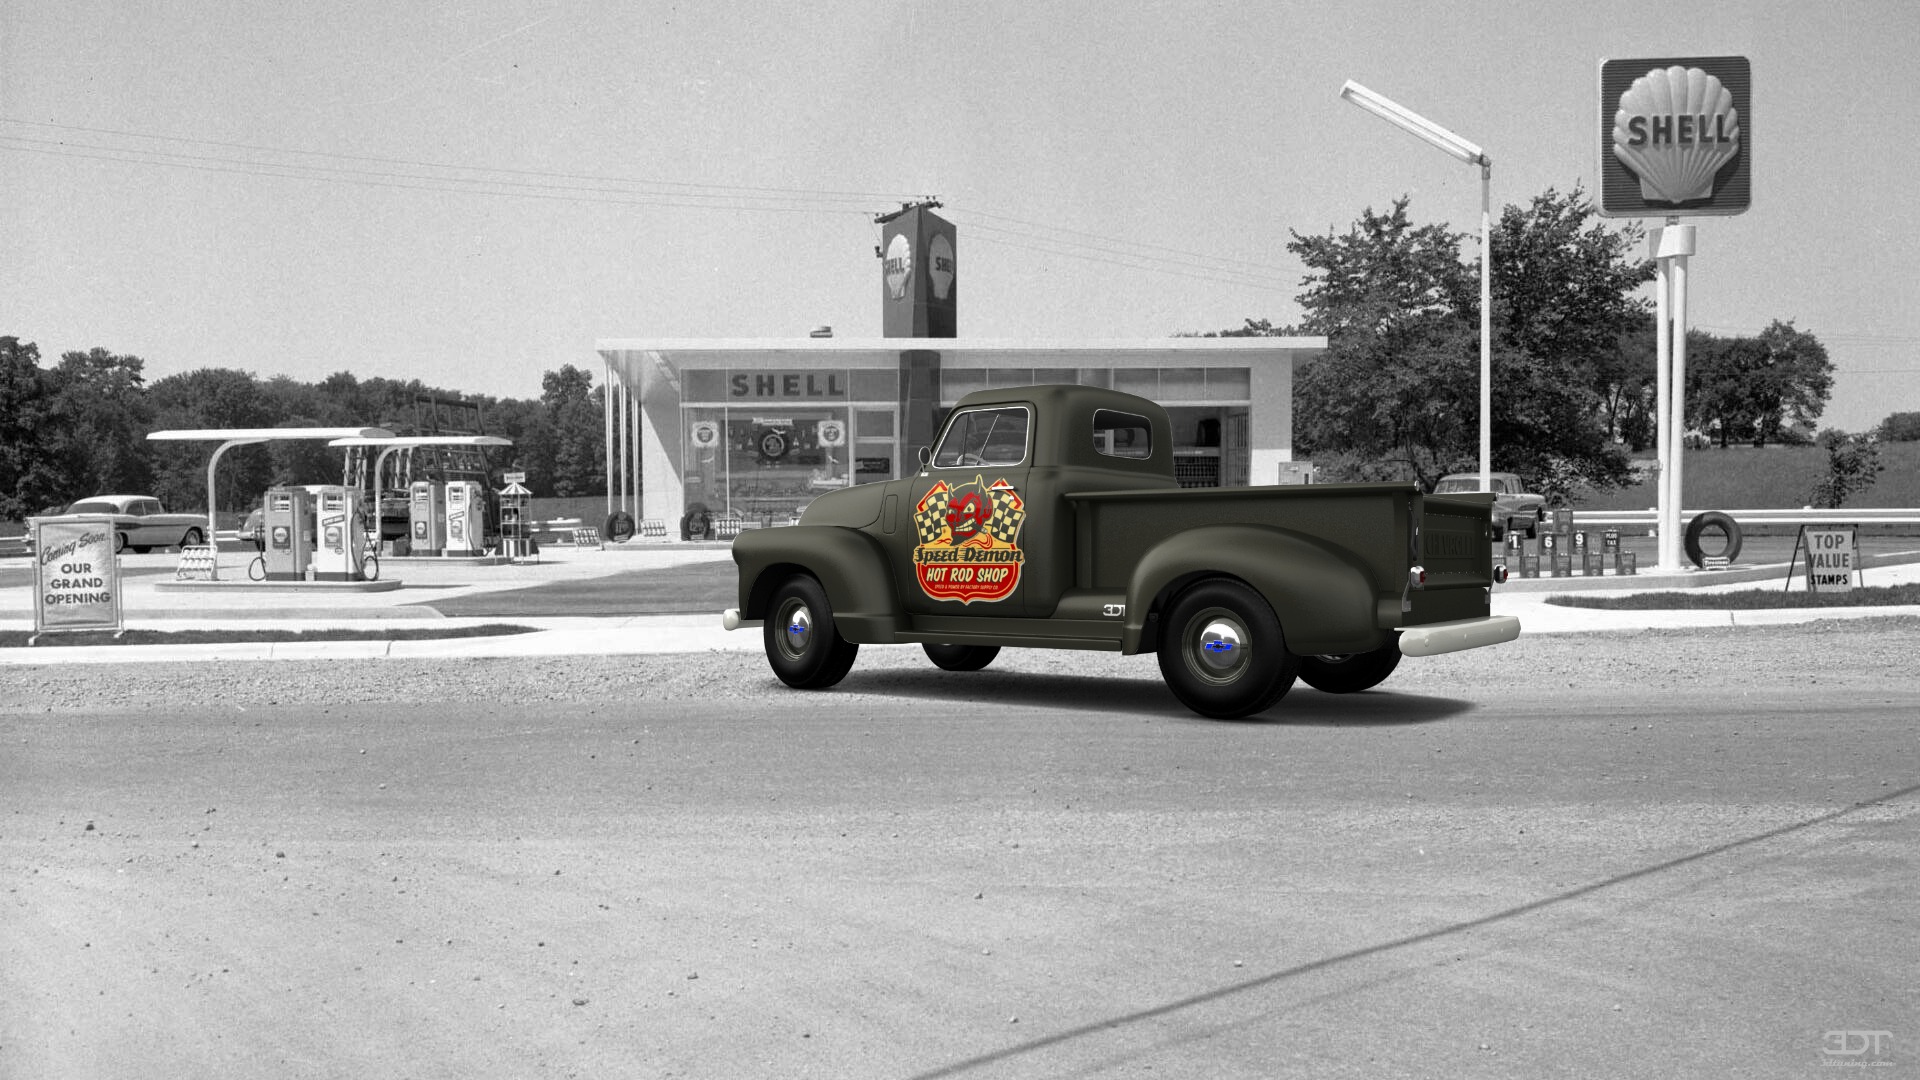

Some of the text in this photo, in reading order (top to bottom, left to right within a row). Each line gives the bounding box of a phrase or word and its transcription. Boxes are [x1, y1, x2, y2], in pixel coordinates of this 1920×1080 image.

[1628, 114, 1730, 146] SHELL
[732, 374, 844, 397] SHELL
[1544, 536, 1553, 548] 6
[1575, 533, 1584, 545] 9
[1814, 534, 1845, 549] TOP
[40, 532, 106, 566] Coming Soon
[915, 547, 1022, 565] Speed Demon
[1809, 553, 1850, 568] VALUE
[61, 563, 92, 574] OUR
[926, 568, 1009, 583] HOT ROD SHOP
[51, 577, 104, 589] GRAND
[1810, 574, 1849, 586] STAMPS
[45, 592, 111, 605] OPENING
